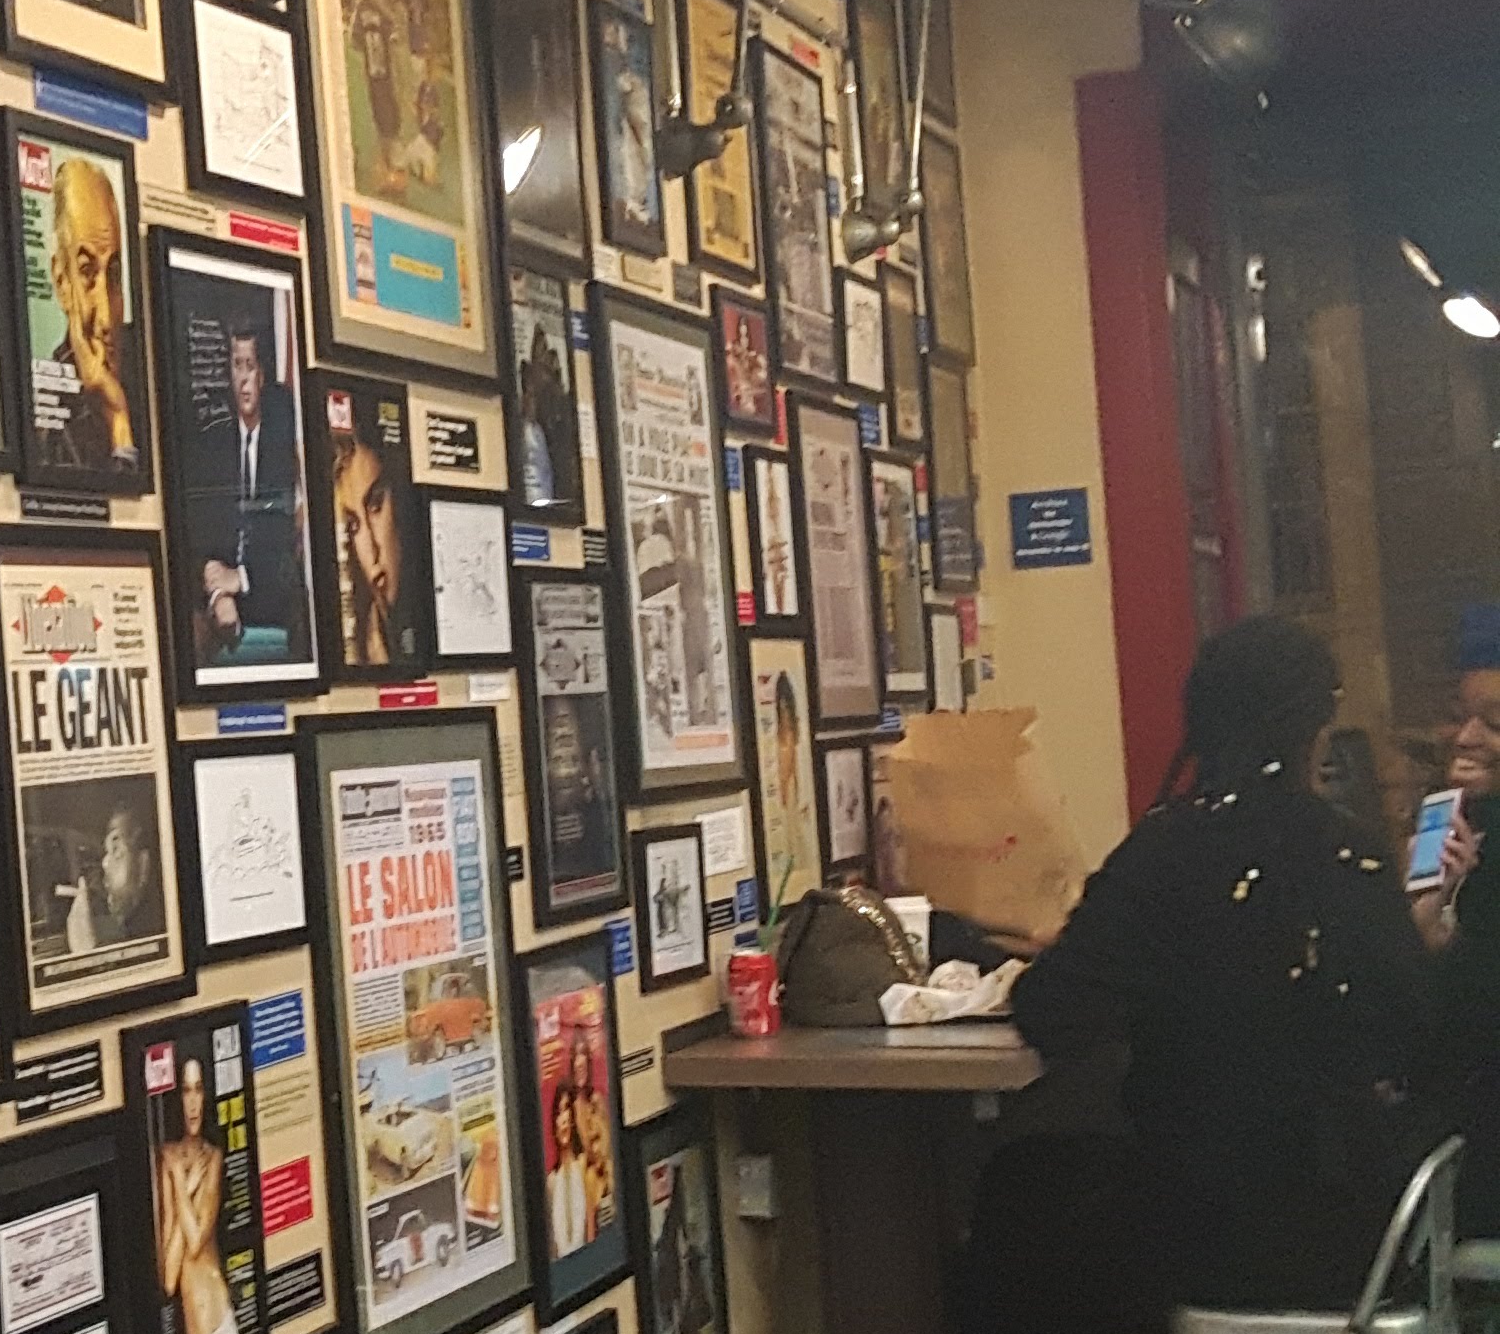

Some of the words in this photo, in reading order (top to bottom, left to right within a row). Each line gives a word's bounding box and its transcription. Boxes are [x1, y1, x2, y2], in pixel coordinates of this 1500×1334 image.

[11, 669, 51, 753] LE
[347, 860, 373, 926] LE
[380, 849, 455, 919] SALON
